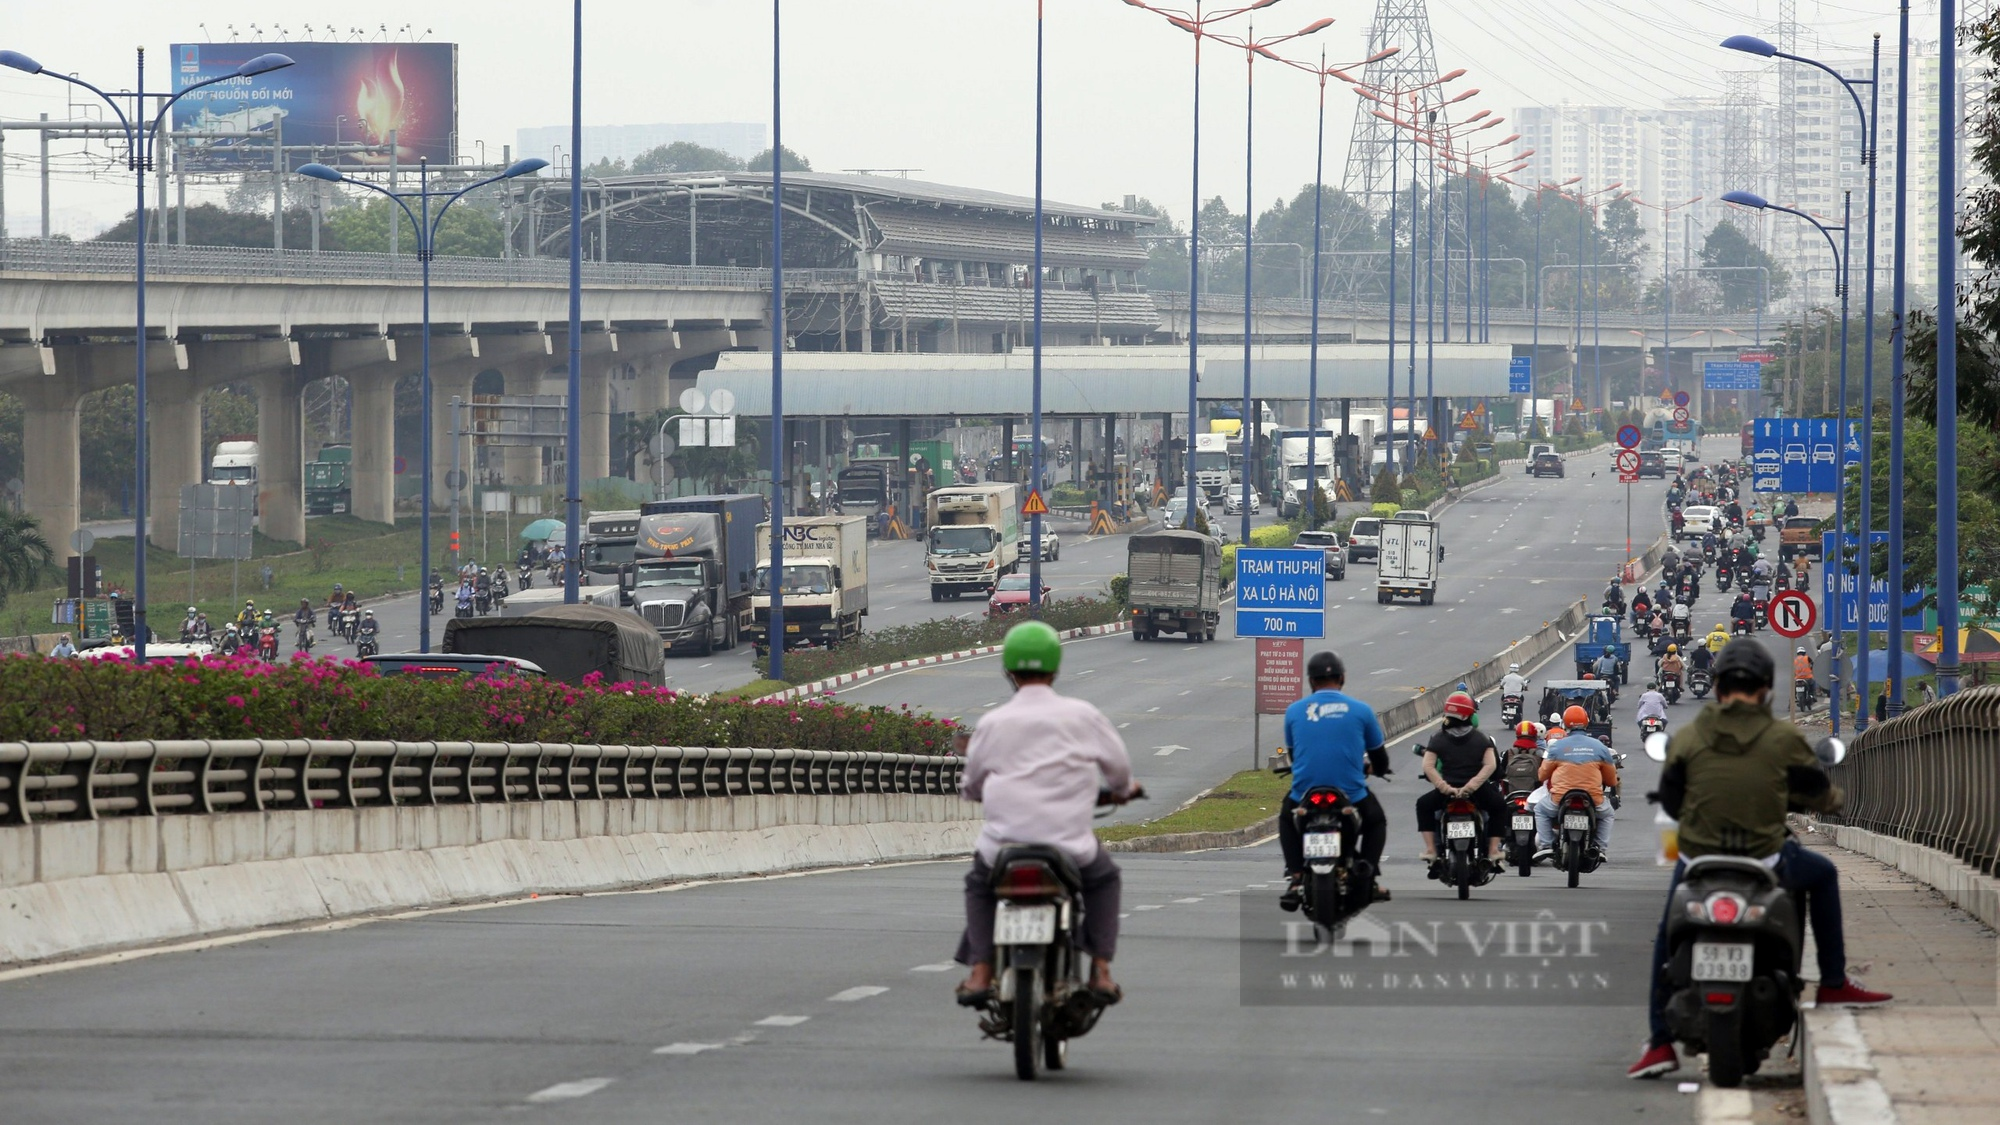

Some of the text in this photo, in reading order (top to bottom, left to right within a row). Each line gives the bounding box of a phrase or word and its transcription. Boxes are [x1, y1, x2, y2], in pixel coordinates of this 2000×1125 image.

[252, 86, 270, 100] ĐỔI
[273, 86, 293, 100] MỚI
[784, 524, 818, 541] NBC
[1413, 539, 1427, 547] VTL
[1241, 557, 1322, 577] TRẠM THU PHÍ
[1827, 573, 1854, 593] ĐNG
[1243, 584, 1319, 605] XA LỘ HÀ NỘI
[1264, 617, 1297, 632] 700 m
[1452, 822, 1470, 831] 60-B5
